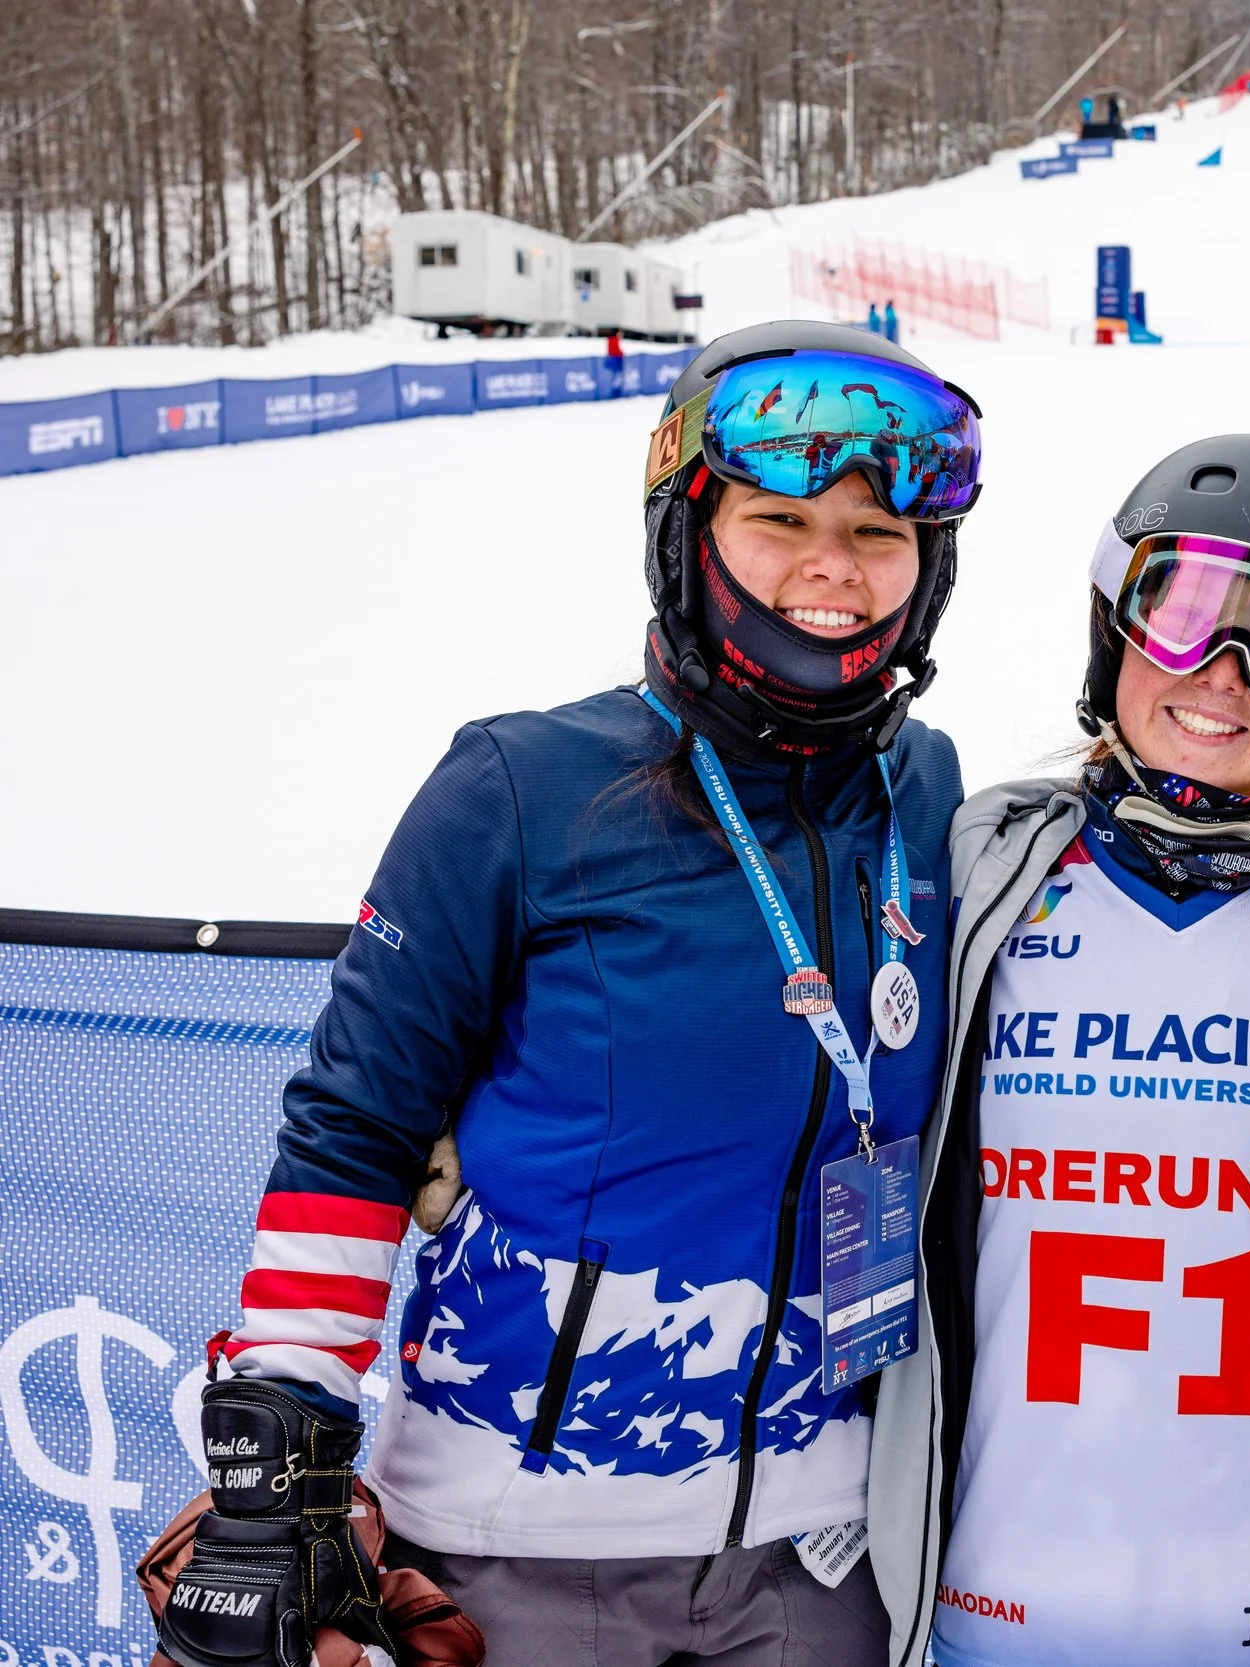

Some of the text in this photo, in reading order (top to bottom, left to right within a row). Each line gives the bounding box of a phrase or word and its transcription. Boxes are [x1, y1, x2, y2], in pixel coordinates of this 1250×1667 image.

[29, 416, 104, 455] ESPN
[700, 753, 713, 774] 2023
[709, 775, 727, 801] FISU
[723, 802, 747, 844] WORLD
[743, 845, 784, 918] UNIVERSITY
[778, 920, 803, 965] GAMES
[890, 849, 900, 903] UNIVERSI
[901, 971, 917, 1003] TEAM
[889, 975, 914, 1027] USA
[984, 1012, 1058, 1060] KE
[994, 1072, 1096, 1096] WORLD
[826, 1208, 845, 1220] VILLAGE
[881, 1206, 906, 1220] TRANSPORT
[826, 1222, 860, 1240] VILLAGE DINING
[826, 1239, 869, 1260] MAIN PRESS CENTER
[874, 1354, 890, 1367] FISU
[833, 1369, 848, 1386] NY
[207, 1436, 260, 1456] Vertical Cut
[225, 1467, 263, 1489] COMP
[807, 1531, 826, 1555] Adult
[818, 1531, 844, 1561] January
[172, 1583, 262, 1617] SKI TEAM
